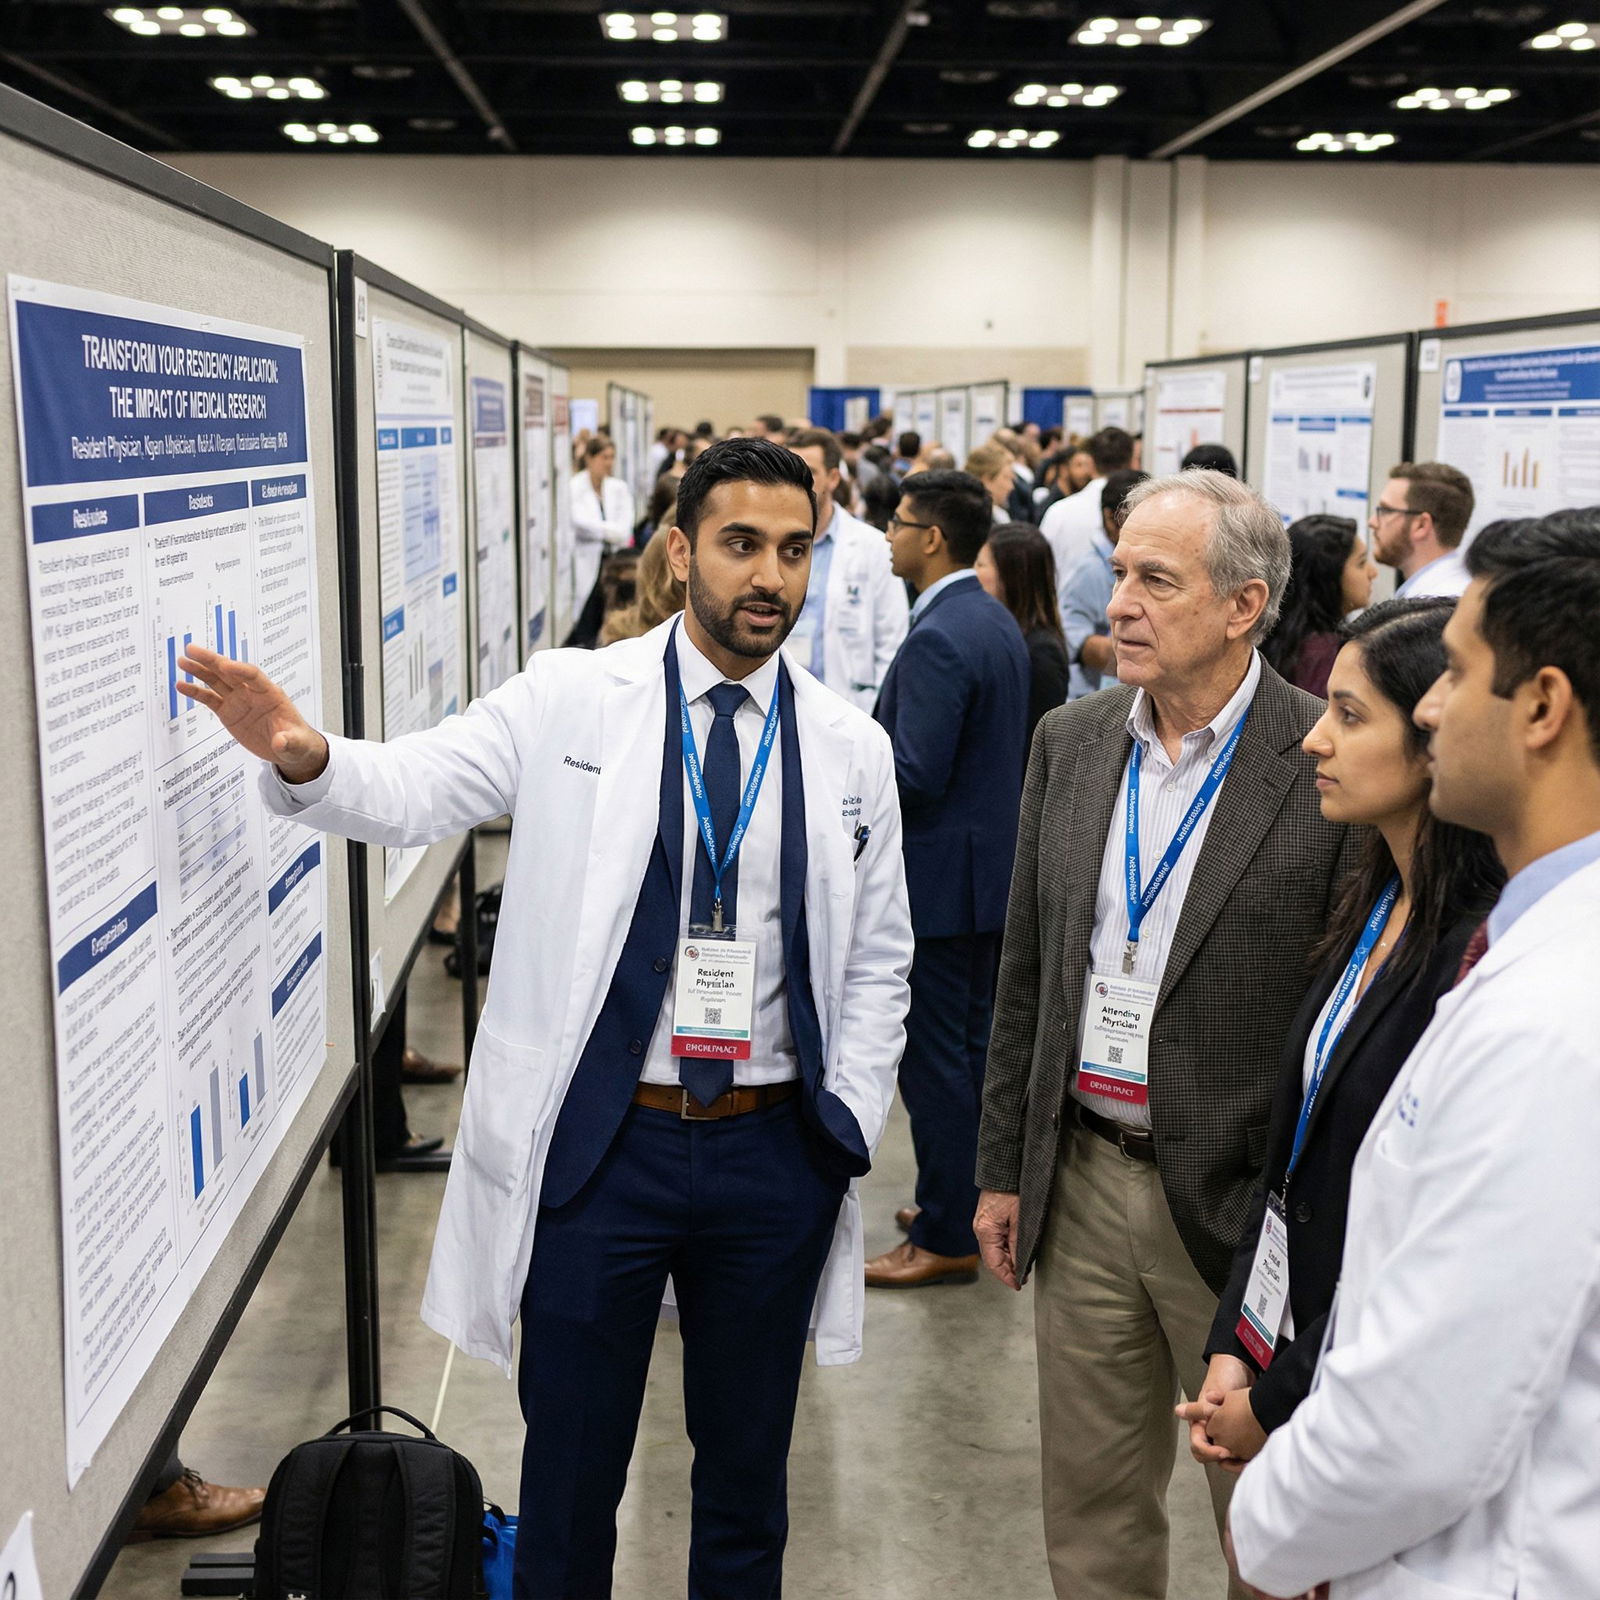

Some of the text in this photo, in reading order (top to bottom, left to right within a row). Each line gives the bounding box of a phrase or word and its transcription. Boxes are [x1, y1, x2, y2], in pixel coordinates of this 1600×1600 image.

[81, 334, 279, 384] TRANSFORM YOUR RESIDENCY APPLICATION:
[109, 386, 267, 420] THE IMPACT OF MEDICAL RESEARCH
[71, 436, 107, 460] Resident
[697, 968, 734, 978] Resident
[1101, 1005, 1141, 1021] Attending
